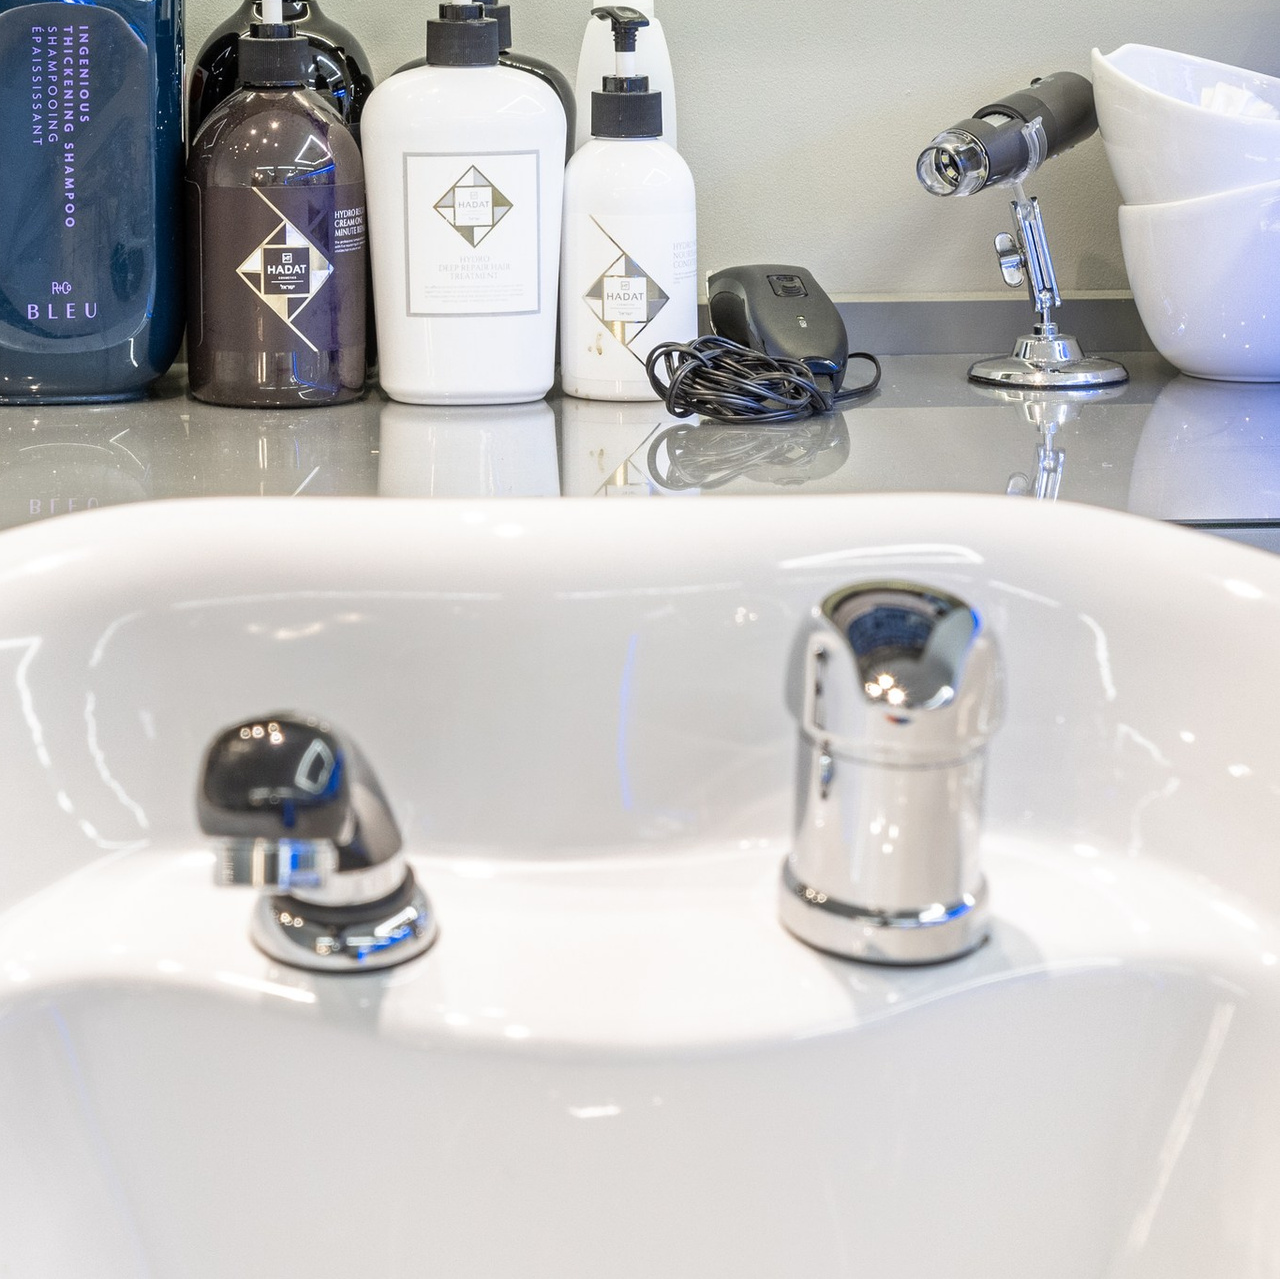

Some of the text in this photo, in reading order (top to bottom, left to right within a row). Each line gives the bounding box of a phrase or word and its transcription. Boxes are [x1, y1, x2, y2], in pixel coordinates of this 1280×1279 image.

[79, 25, 90, 123] INGENIOUS
[32, 26, 44, 145] ÉPAISSISSANT
[48, 26, 58, 143] SHAMPOOING
[64, 26, 75, 227] THICKENING SHAMPOO
[335, 209, 355, 219] HYDRO
[335, 219, 354, 227] CREAM
[335, 227, 357, 237] MINUTE
[267, 265, 306, 274] HADAT
[607, 293, 644, 301] HADAT
[27, 302, 98, 320] BLEU
